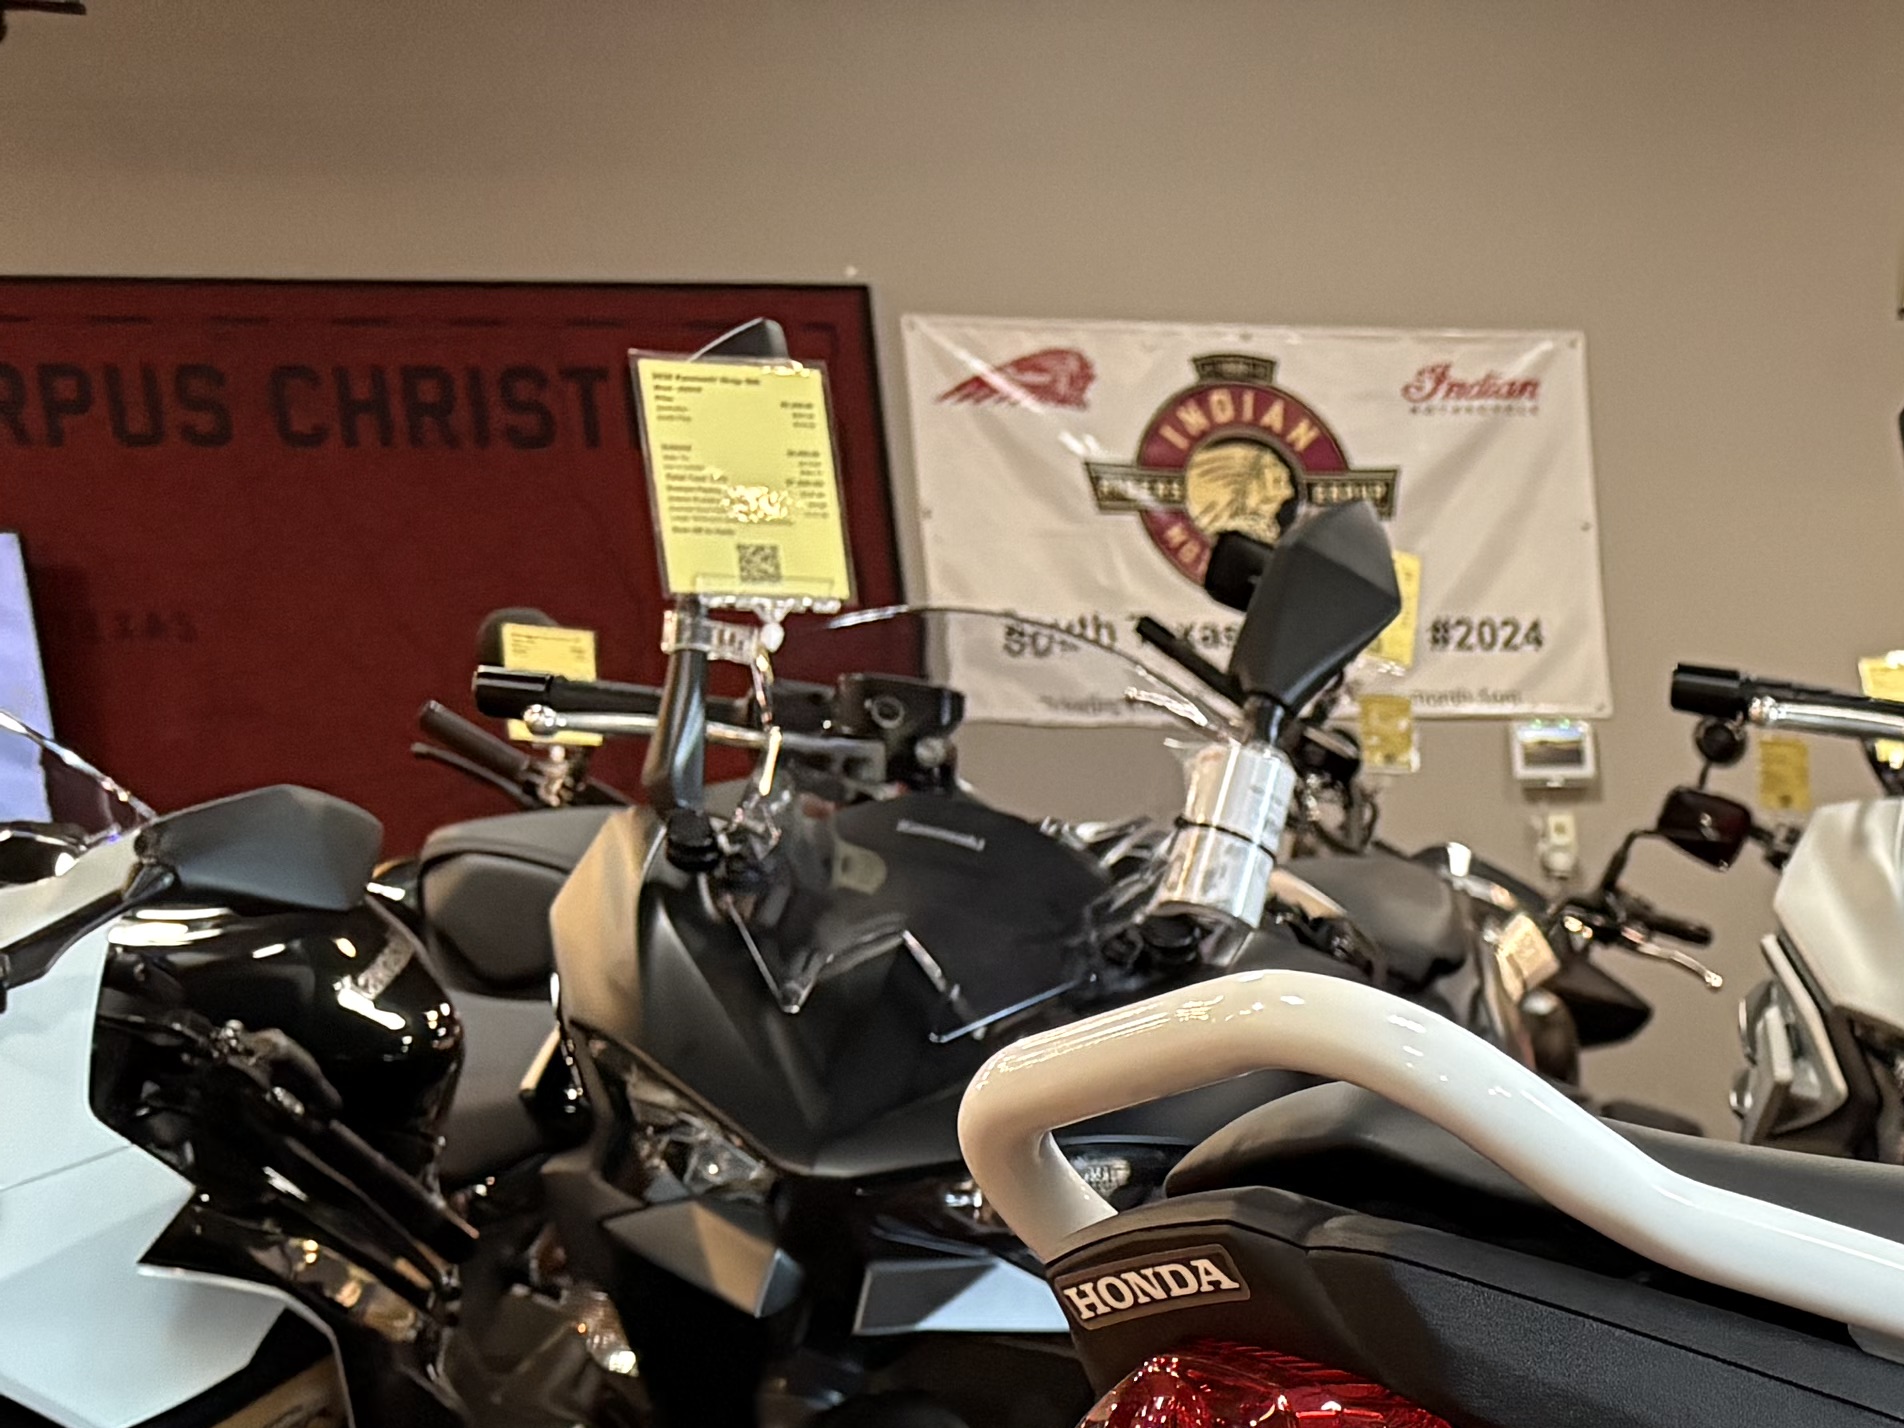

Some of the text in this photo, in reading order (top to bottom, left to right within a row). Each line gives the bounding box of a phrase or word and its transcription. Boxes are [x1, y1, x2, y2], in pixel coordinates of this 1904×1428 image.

[1401, 362, 1541, 404] Indian
[1158, 387, 1321, 451] INDIAN
[1426, 614, 1545, 652] #2024
[1062, 1257, 1240, 1321] HONDA
